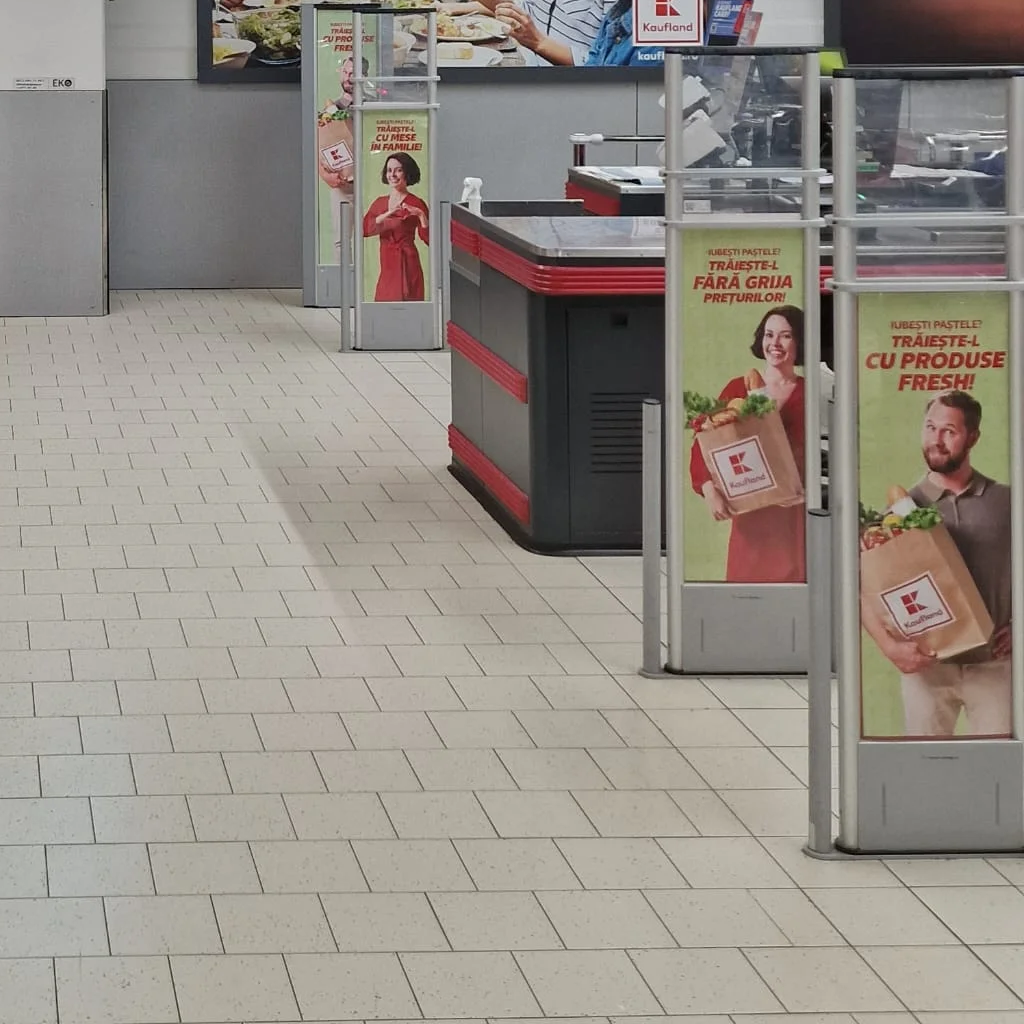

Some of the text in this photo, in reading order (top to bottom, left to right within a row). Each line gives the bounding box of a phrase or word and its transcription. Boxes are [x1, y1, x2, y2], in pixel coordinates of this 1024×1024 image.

[643, 22, 693, 33] Kaufland
[376, 133, 417, 142] CU MESE
[708, 248, 741, 257] IUBEȘTI
[708, 258, 779, 273] TRĂIEȘTE-L
[692, 272, 793, 290] FĂRĂ GRIJA
[703, 292, 787, 306] PREȚURILOR!
[890, 320, 931, 331] IUBEȘTI
[891, 332, 981, 351] TRĂIEȘTE-L
[865, 351, 1007, 369] CU PRODUSE
[897, 373, 976, 391] FRESH!
